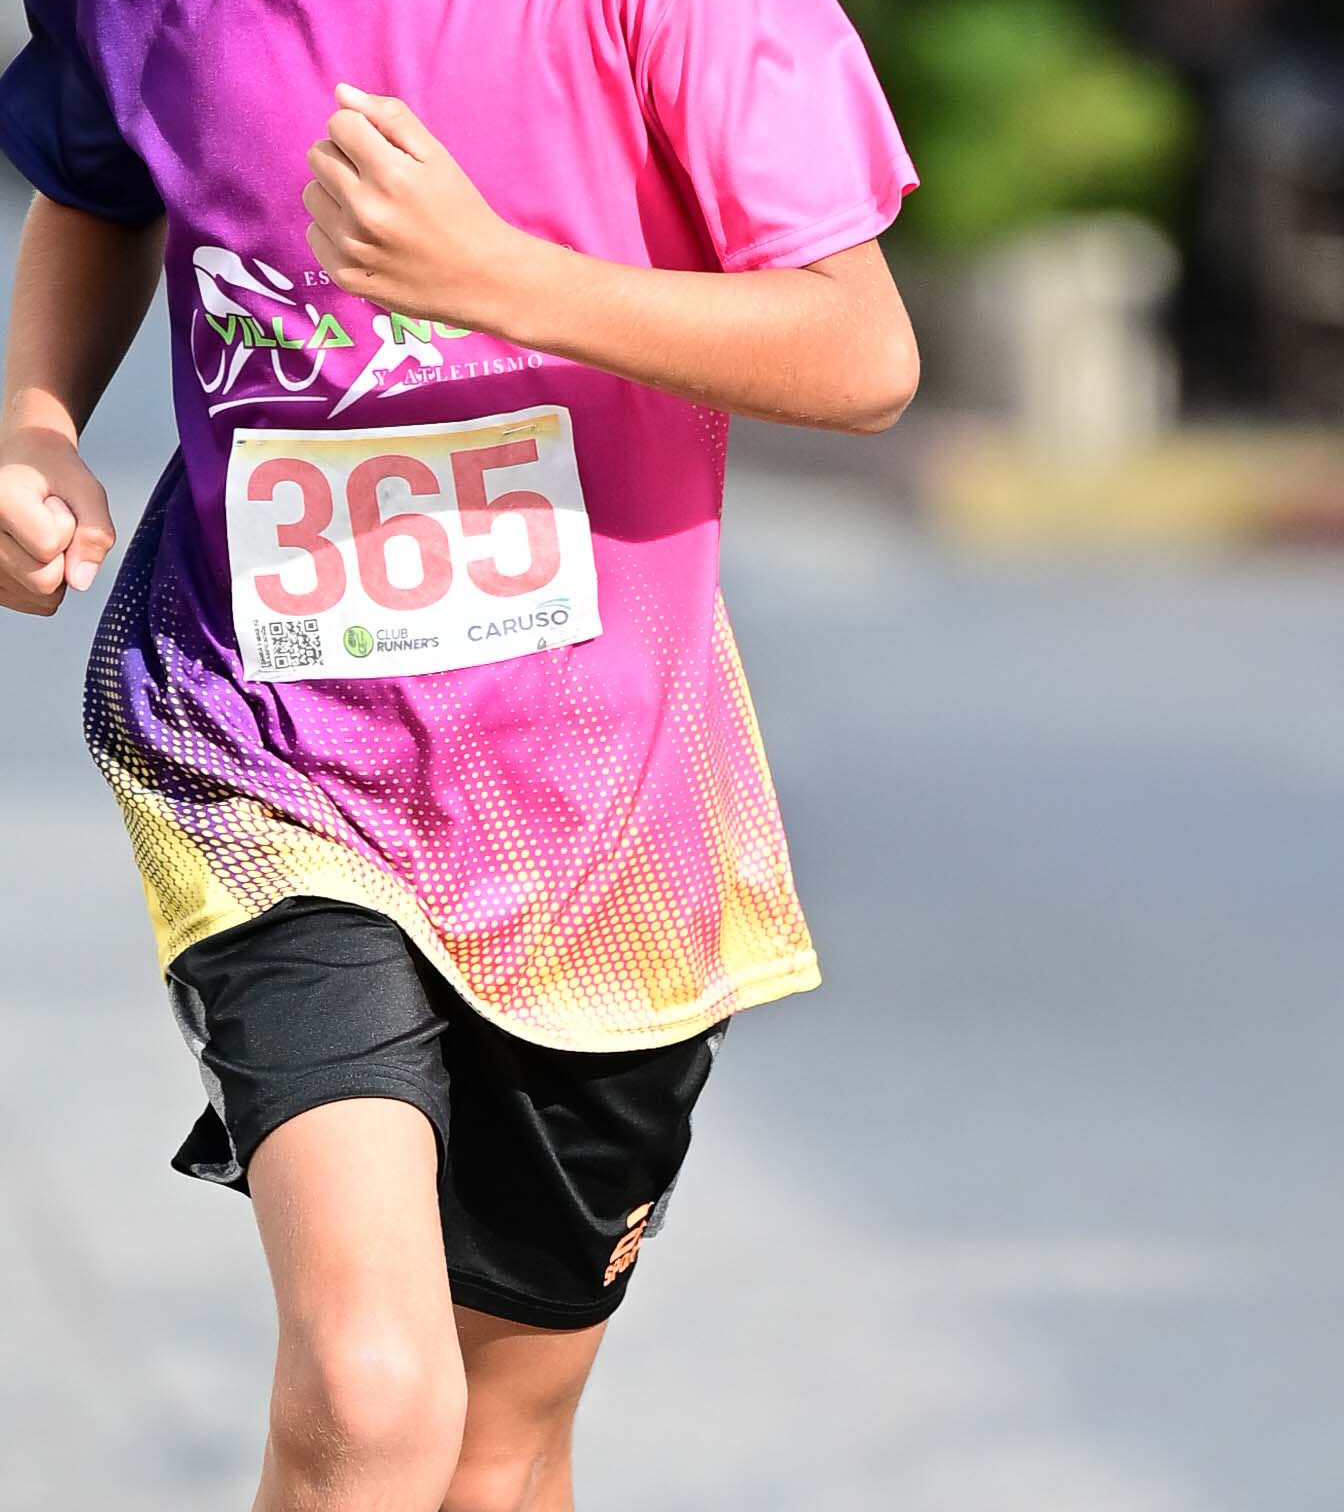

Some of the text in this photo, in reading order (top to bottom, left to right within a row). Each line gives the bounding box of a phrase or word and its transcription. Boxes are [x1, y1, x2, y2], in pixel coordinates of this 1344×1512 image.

[205, 313, 355, 349] VILLA
[373, 354, 543, 386] Y ATLETISMO
[248, 438, 561, 617] 365
[376, 628, 408, 640] CLUB
[467, 610, 569, 641] CARUSO
[377, 637, 439, 652] RUNNER'S
